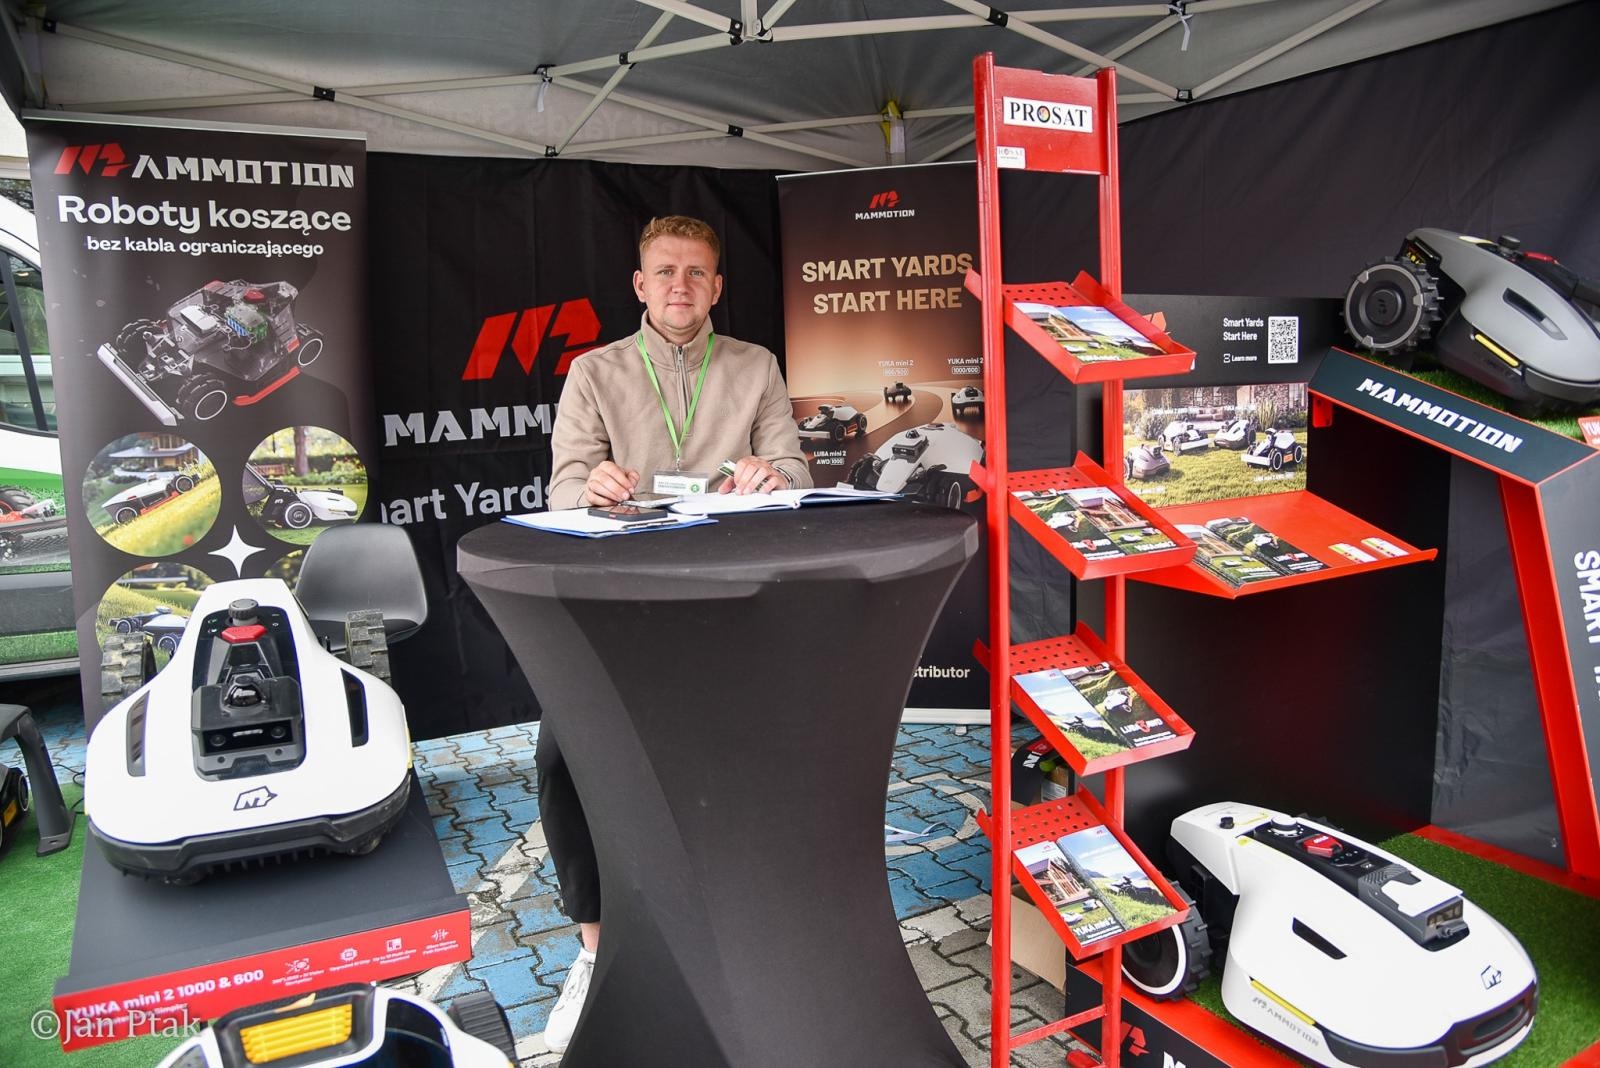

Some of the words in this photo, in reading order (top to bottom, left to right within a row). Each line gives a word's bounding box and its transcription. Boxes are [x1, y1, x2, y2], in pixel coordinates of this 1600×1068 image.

[1010, 101, 1088, 127] PROSAT
[57, 195, 200, 234] Roboty
[208, 200, 352, 236] koszące
[855, 209, 915, 221] MAMMOTION
[87, 236, 121, 251] bez
[125, 237, 175, 253] kabla
[179, 240, 324, 257] ograniczającego
[802, 258, 886, 283] SMART
[891, 253, 973, 278] YARDS
[813, 290, 890, 315] START
[896, 287, 962, 311] HERE
[1223, 317, 1244, 328] Smart
[1245, 317, 1264, 328] Yards
[1223, 331, 1241, 341] Start
[1241, 331, 1258, 341] Here
[382, 403, 559, 447] MAMM
[1356, 378, 1523, 453] MAMMOTION
[380, 488, 447, 526] art
[454, 476, 551, 517] Yard
[68, 999, 121, 1021] YUKA
[123, 991, 161, 1010] mini
[163, 987, 175, 1001] 2
[177, 979, 216, 998] 1000
[218, 976, 232, 989] &
[233, 969, 264, 986] 600
